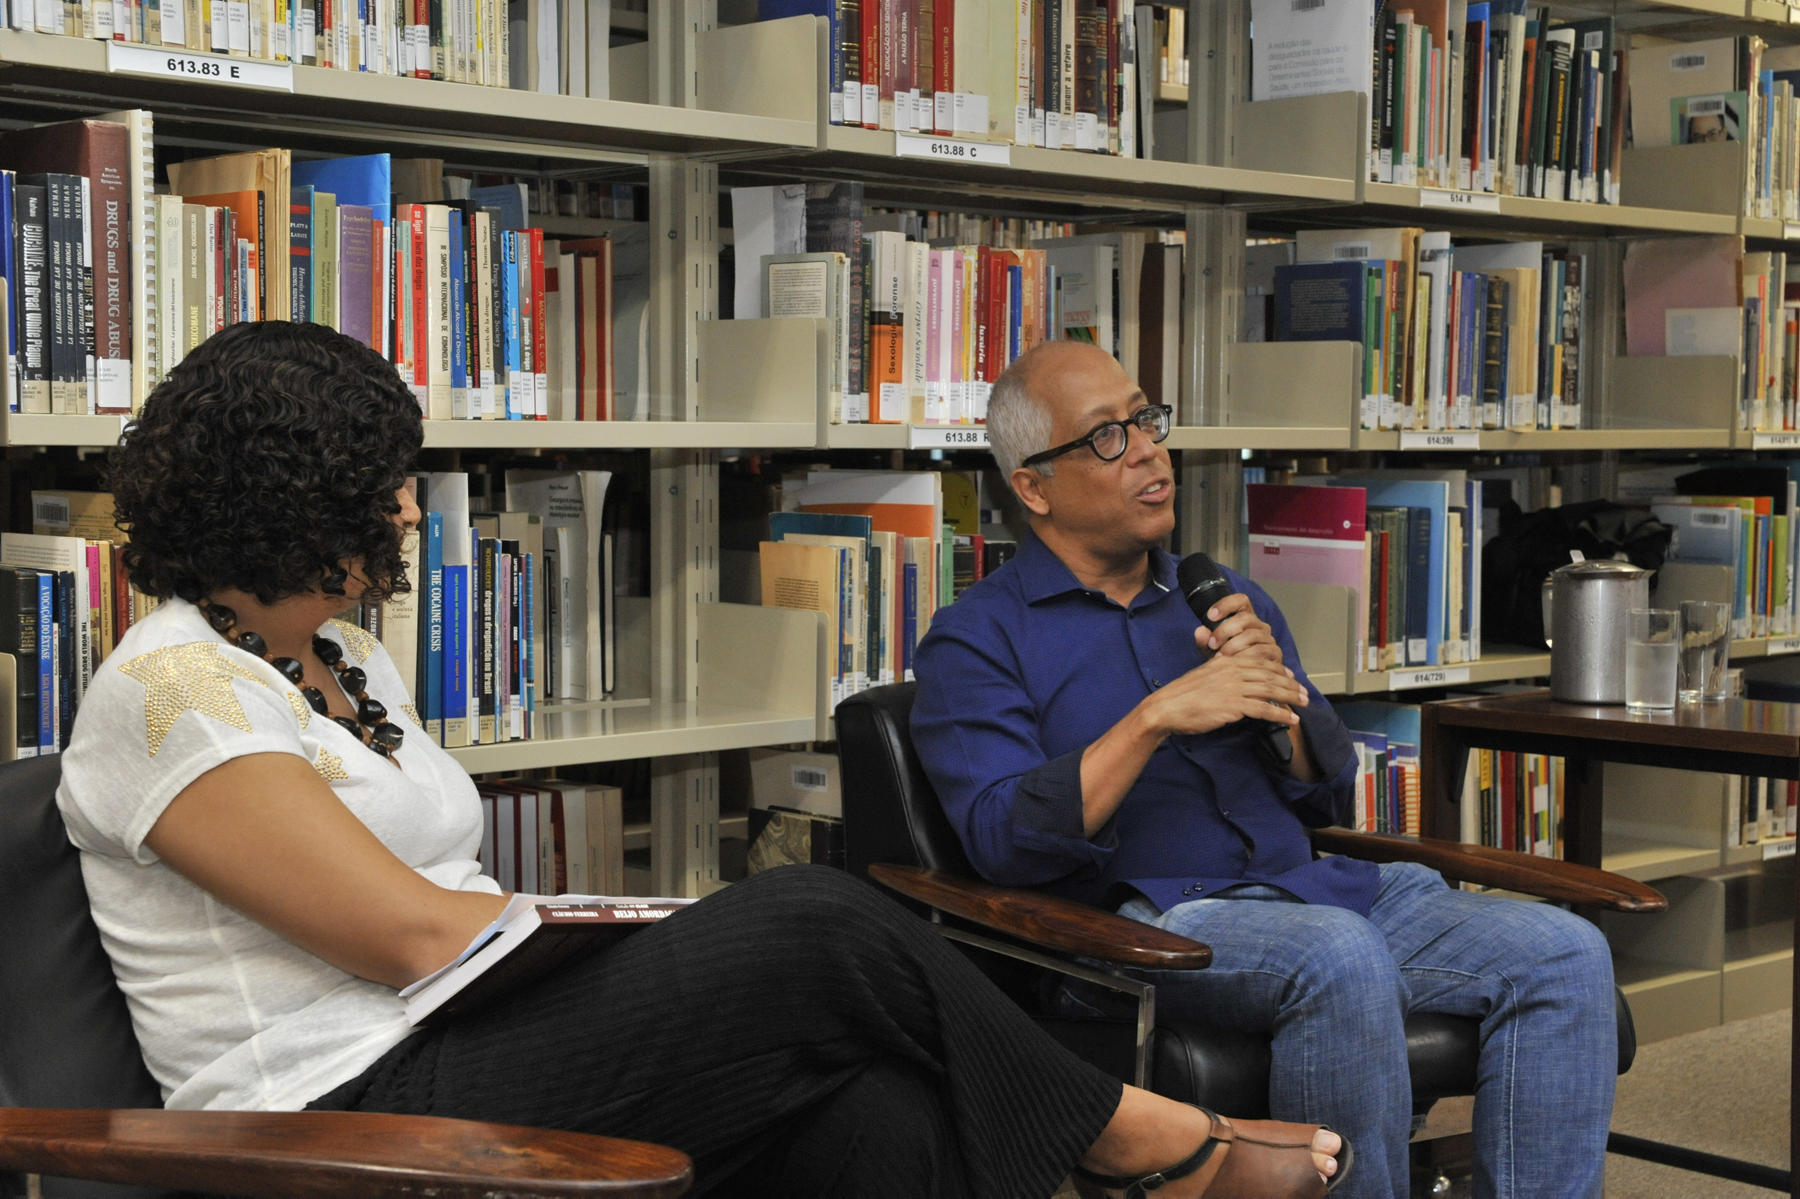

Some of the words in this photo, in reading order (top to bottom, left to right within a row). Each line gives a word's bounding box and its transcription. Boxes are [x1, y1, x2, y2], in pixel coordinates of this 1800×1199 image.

[167, 58, 220, 76] 613.83
[230, 66, 240, 79] E
[932, 144, 964, 156] 613.88
[970, 148, 976, 158] C
[106, 200, 119, 248] DRUGS
[52, 240, 60, 265] DROGAS
[107, 251, 118, 274] and
[26, 271, 40, 285] The
[54, 280, 62, 290] DE
[66, 282, 72, 290] DE
[26, 286, 42, 311] Great
[108, 276, 120, 317] DRUG
[454, 302, 460, 311] de
[26, 312, 42, 338] White
[493, 319, 502, 347] Society
[26, 338, 42, 368] Plague
[889, 324, 897, 374] Sexologia
[946, 432, 978, 442] 613.88
[431, 569, 442, 586] THE
[40, 592, 52, 623] VOCAÇÃO
[431, 587, 442, 622] COCAINE
[484, 590, 493, 616] drogas
[42, 624, 50, 634] DO
[431, 625, 442, 651] CRISIS
[42, 635, 52, 659] ÊXTASE
[613, 910, 638, 919] BEIJO
